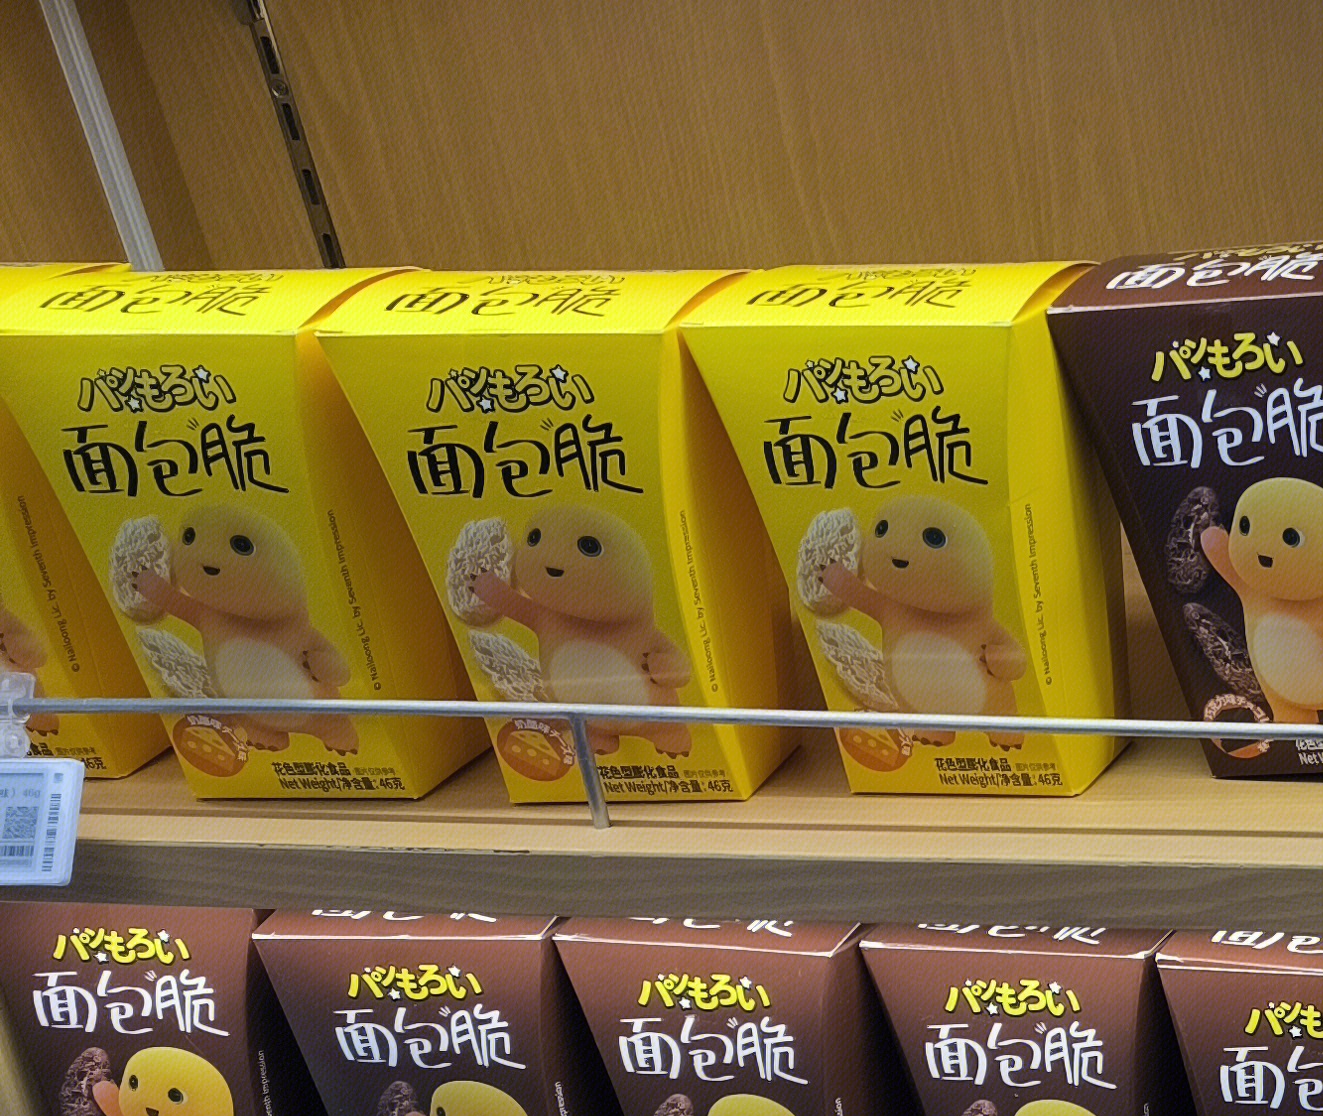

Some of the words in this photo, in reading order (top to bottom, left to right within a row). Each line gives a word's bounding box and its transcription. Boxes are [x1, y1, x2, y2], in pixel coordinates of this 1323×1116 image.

[61, 414, 290, 498] 面包脆
[407, 415, 645, 498] 面包脆
[764, 405, 988, 489] 面包脆
[279, 778, 298, 790] Net
[604, 780, 624, 794] Net
[31, 970, 230, 1037] 面包脆
[332, 1006, 527, 1071] 面包脆
[617, 1016, 808, 1085] 面包脆
[924, 1022, 1117, 1090] 面包脆
